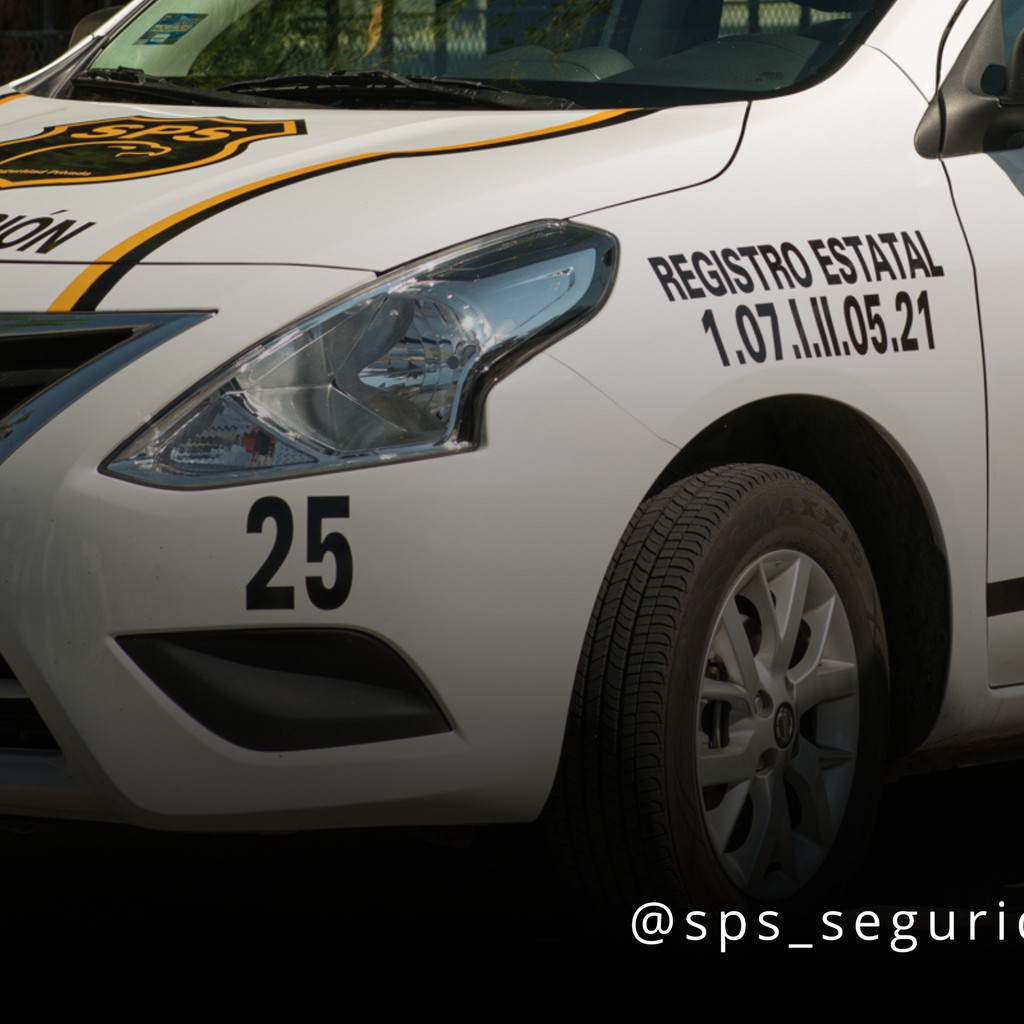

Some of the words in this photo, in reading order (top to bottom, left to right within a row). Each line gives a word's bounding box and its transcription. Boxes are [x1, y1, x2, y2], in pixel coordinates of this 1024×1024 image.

[70, 124, 247, 142] SPS
[647, 241, 813, 302] REGISTRO
[807, 230, 945, 285] ESTATAL
[701, 290, 935, 367] 1.07.I.II.05.21
[246, 495, 353, 611] 25
